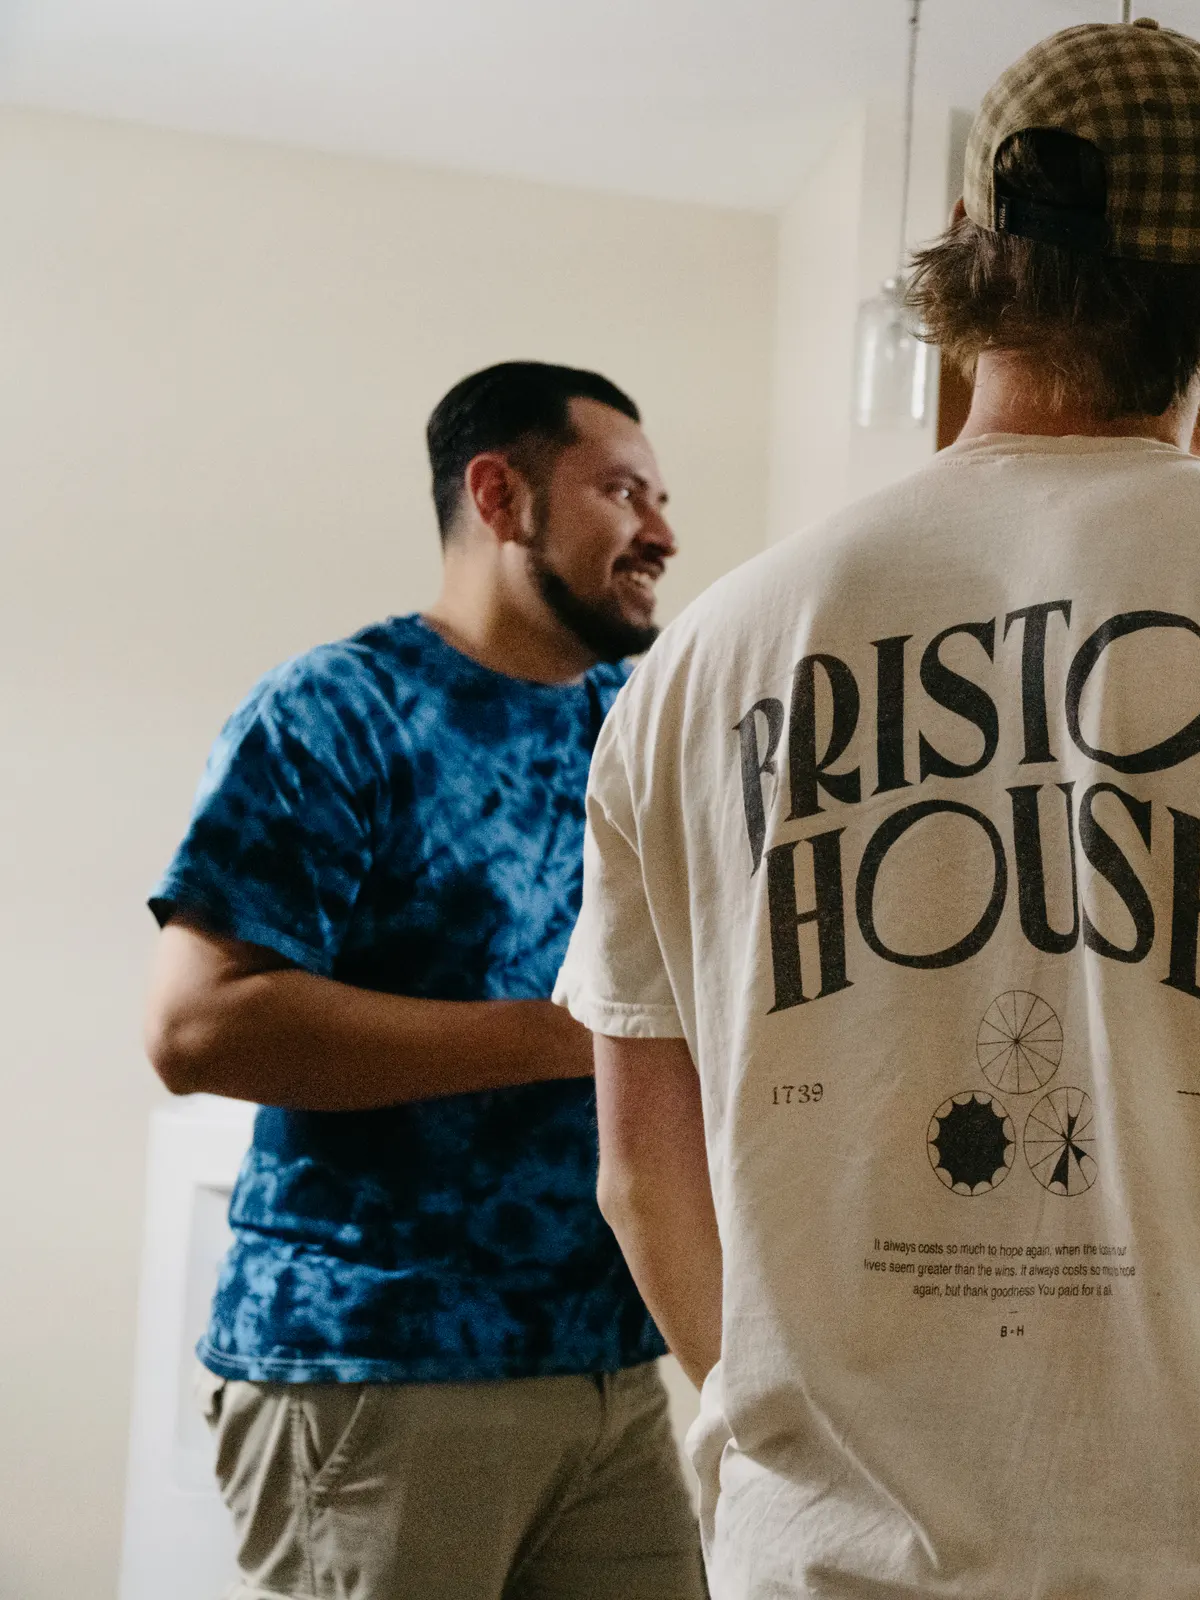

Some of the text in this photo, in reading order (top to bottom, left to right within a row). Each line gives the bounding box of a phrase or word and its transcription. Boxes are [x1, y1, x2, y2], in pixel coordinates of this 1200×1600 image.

[772, 1083, 824, 1105] 1739
[874, 1238, 880, 1251] It
[883, 1240, 916, 1255] always
[918, 1243, 944, 1254] costs
[946, 1244, 957, 1254] so
[960, 1243, 985, 1255] much
[988, 1244, 997, 1256] to
[1000, 1244, 1023, 1259] hope
[1055, 1244, 1080, 1255] when
[1083, 1243, 1097, 1255] the
[864, 1259, 886, 1272] lives
[889, 1262, 915, 1273] seem
[917, 1263, 952, 1277] greater
[954, 1263, 975, 1275] than
[978, 1264, 992, 1276] the
[995, 1264, 1017, 1276] wins.
[1029, 1264, 1060, 1278] always
[1062, 1264, 1088, 1276] costs
[1090, 1266, 1100, 1276] so
[913, 1284, 942, 1298] again,
[945, 1284, 961, 1297] but
[963, 1284, 988, 1297] thank
[991, 1285, 1035, 1300] goodness
[1038, 1284, 1056, 1296] You
[1058, 1284, 1079, 1298] paid
[1081, 1283, 1094, 1296] for
